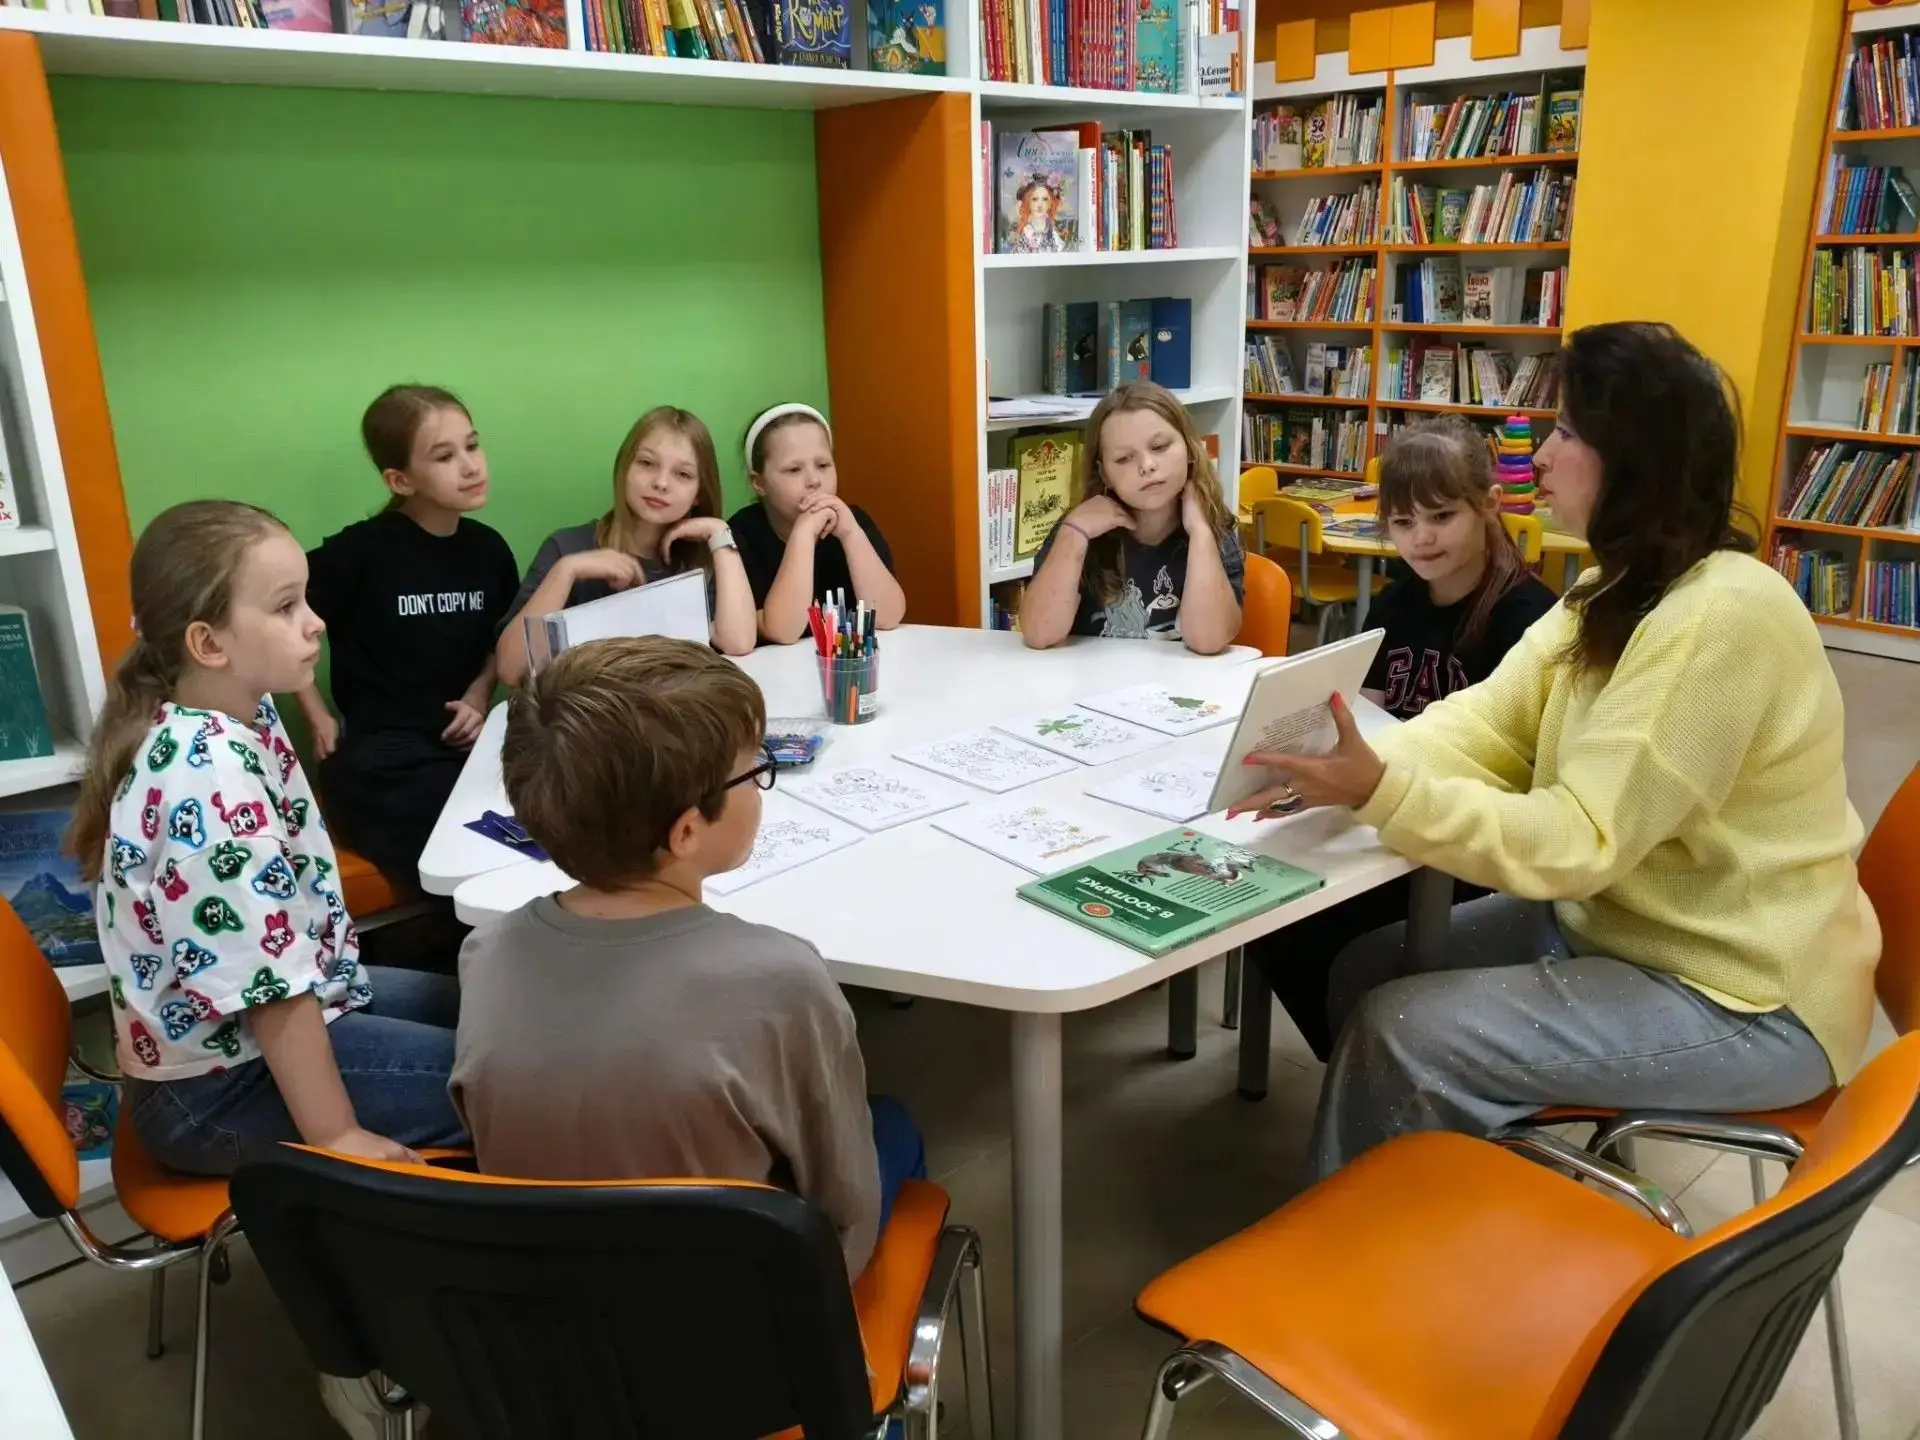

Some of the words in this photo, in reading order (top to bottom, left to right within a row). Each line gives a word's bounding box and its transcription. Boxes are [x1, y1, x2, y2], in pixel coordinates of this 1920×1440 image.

[397, 593, 435, 616] DON'T
[437, 591, 466, 613] COPY
[1076, 876, 1161, 913] ЗООПАРКЕ
[1158, 910, 1176, 919] В
